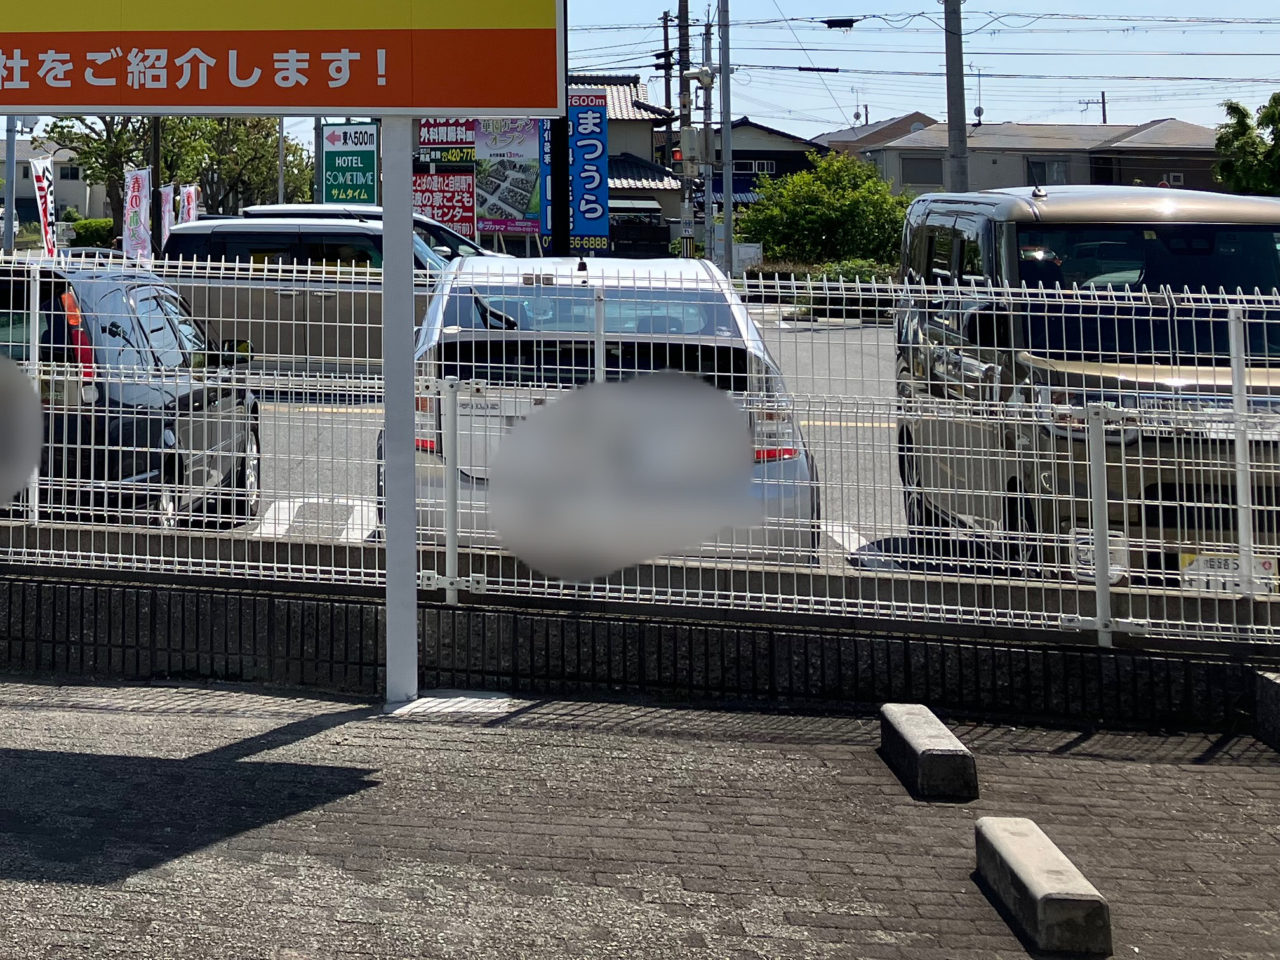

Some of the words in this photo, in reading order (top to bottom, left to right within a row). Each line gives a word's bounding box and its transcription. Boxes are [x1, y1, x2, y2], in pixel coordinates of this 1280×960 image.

[335, 156, 364, 167] HOTEL
[576, 110, 604, 219] まつうら
[326, 171, 374, 185] SOMETIME
[331, 188, 368, 200] サムタイム
